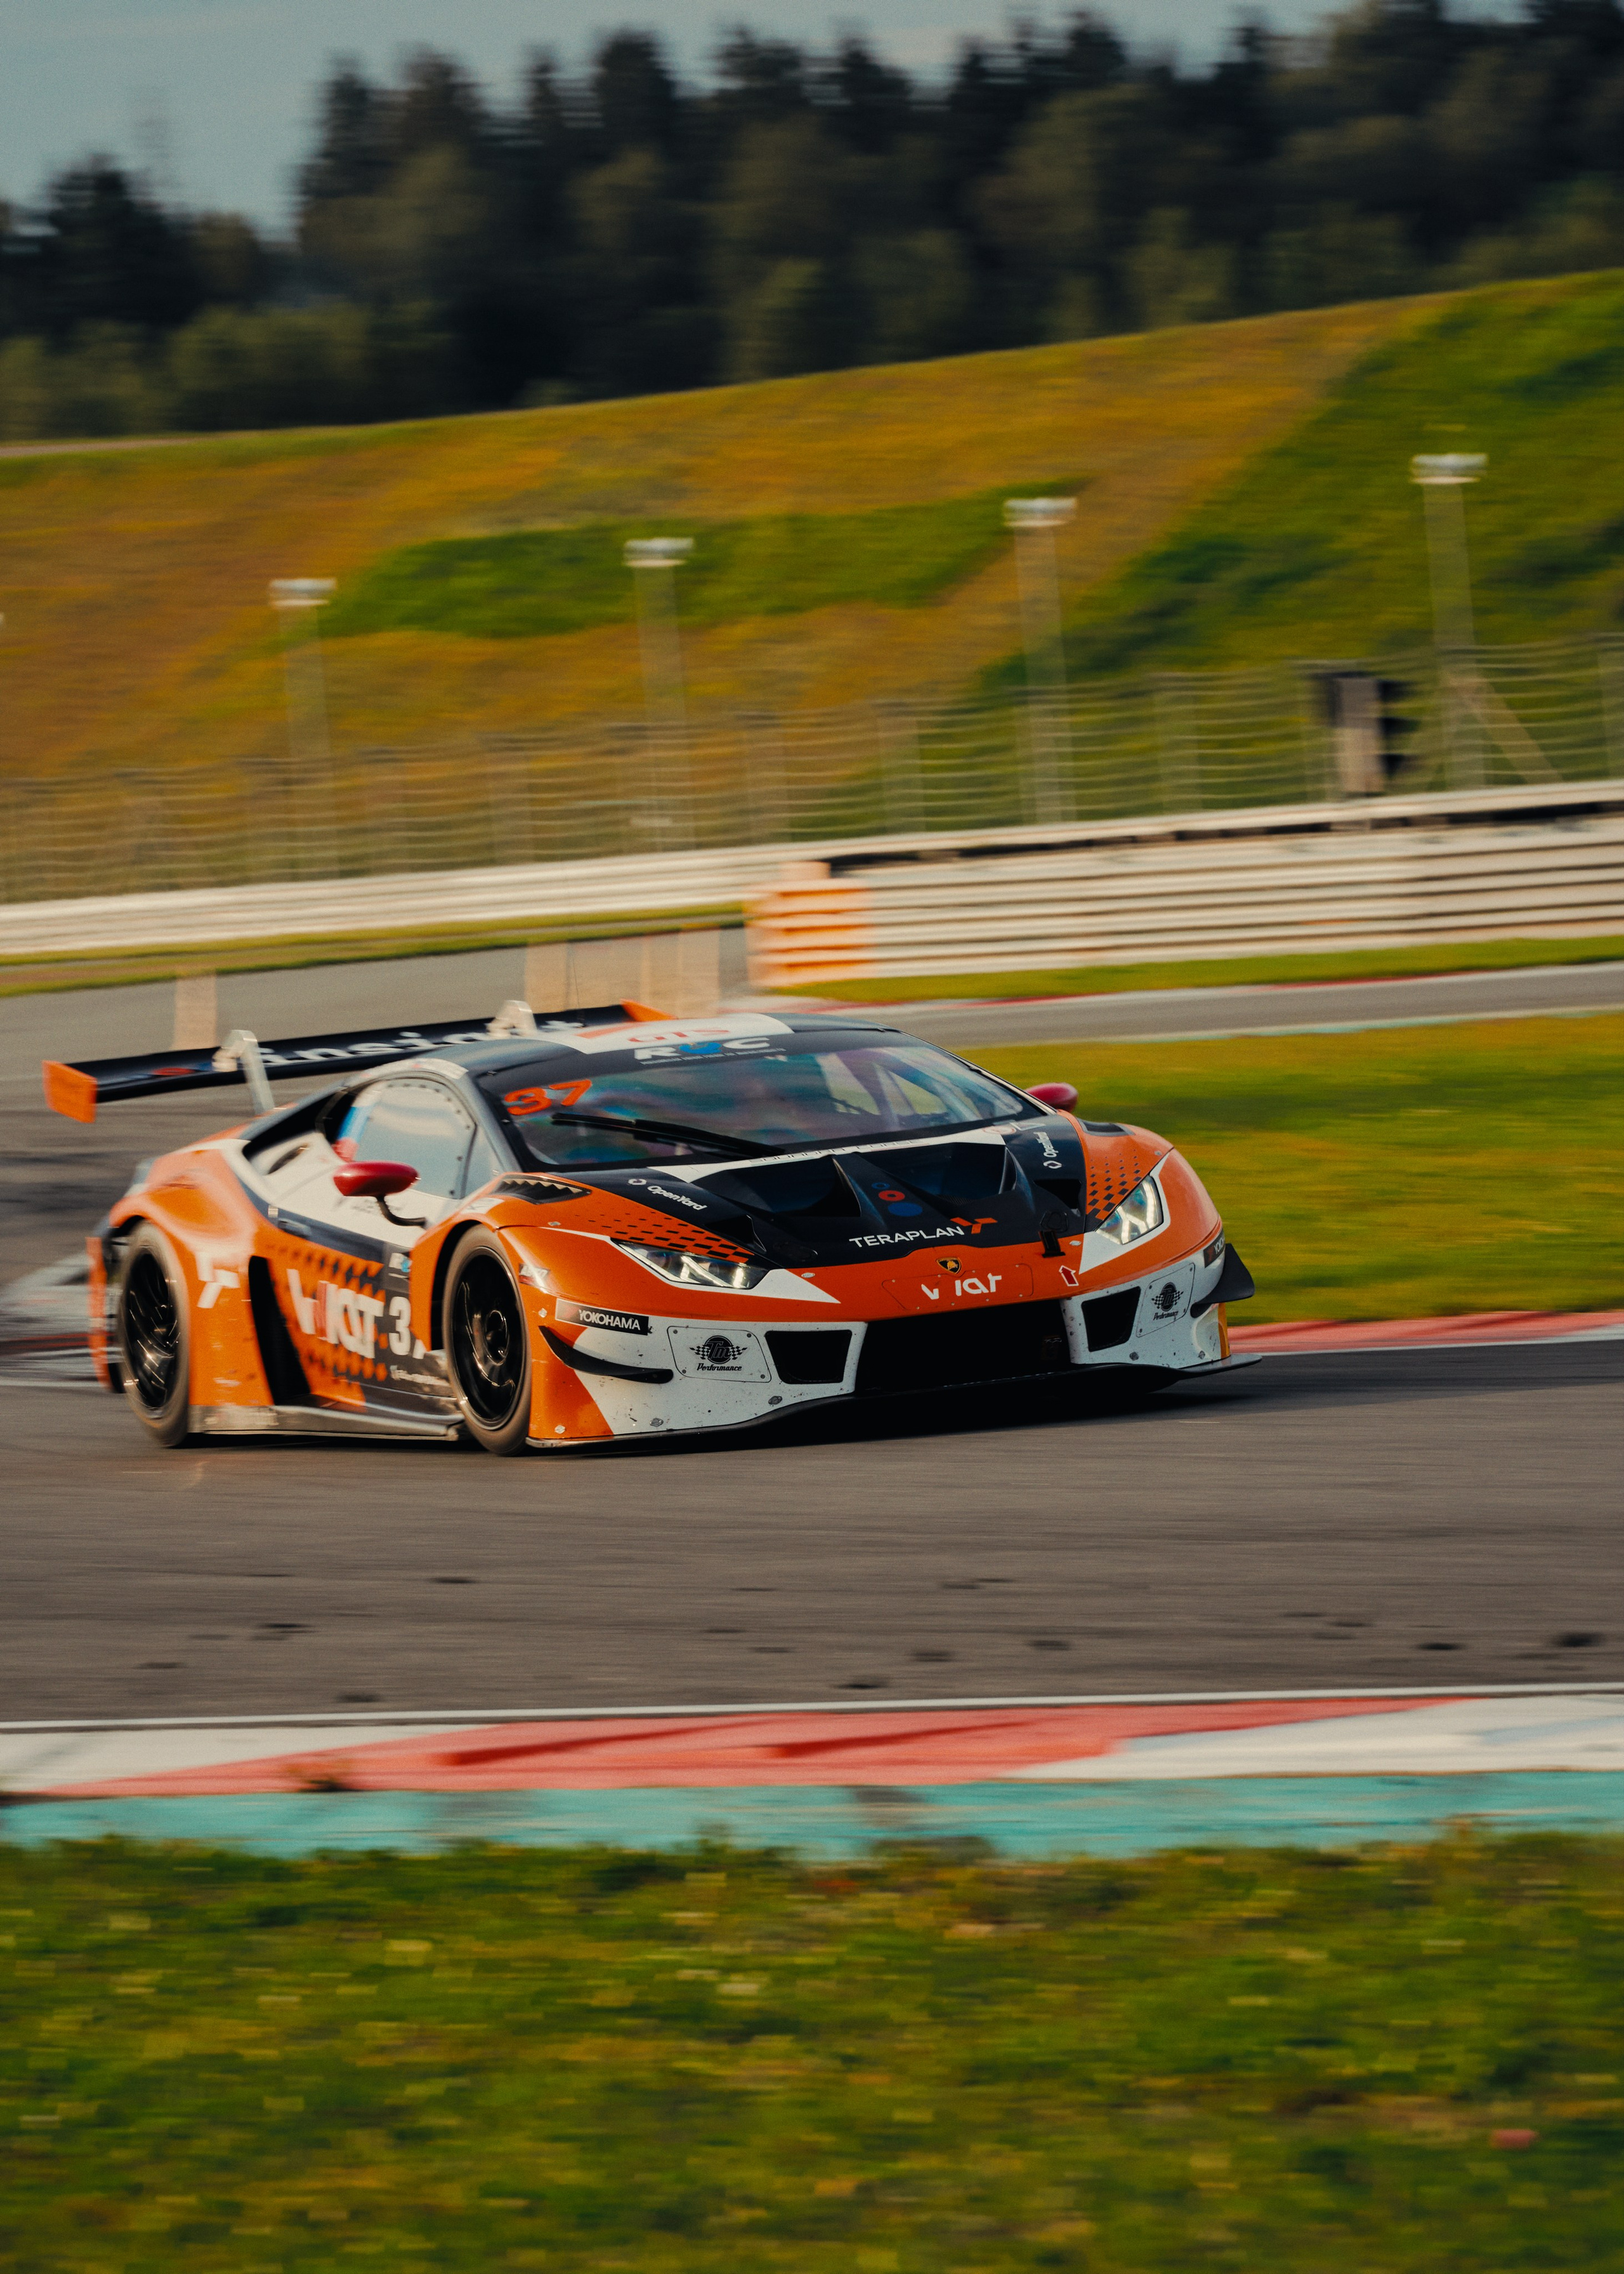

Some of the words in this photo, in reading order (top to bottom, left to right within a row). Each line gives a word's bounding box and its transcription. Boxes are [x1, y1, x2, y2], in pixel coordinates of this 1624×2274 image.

[504, 1079, 593, 1115] 37
[647, 1185, 707, 1211] OpenYard
[849, 1226, 965, 1247] TERAPLAN
[389, 1296, 426, 1359] 3
[579, 1309, 641, 1331] YOKOHAMA
[697, 1363, 742, 1371] Performance
